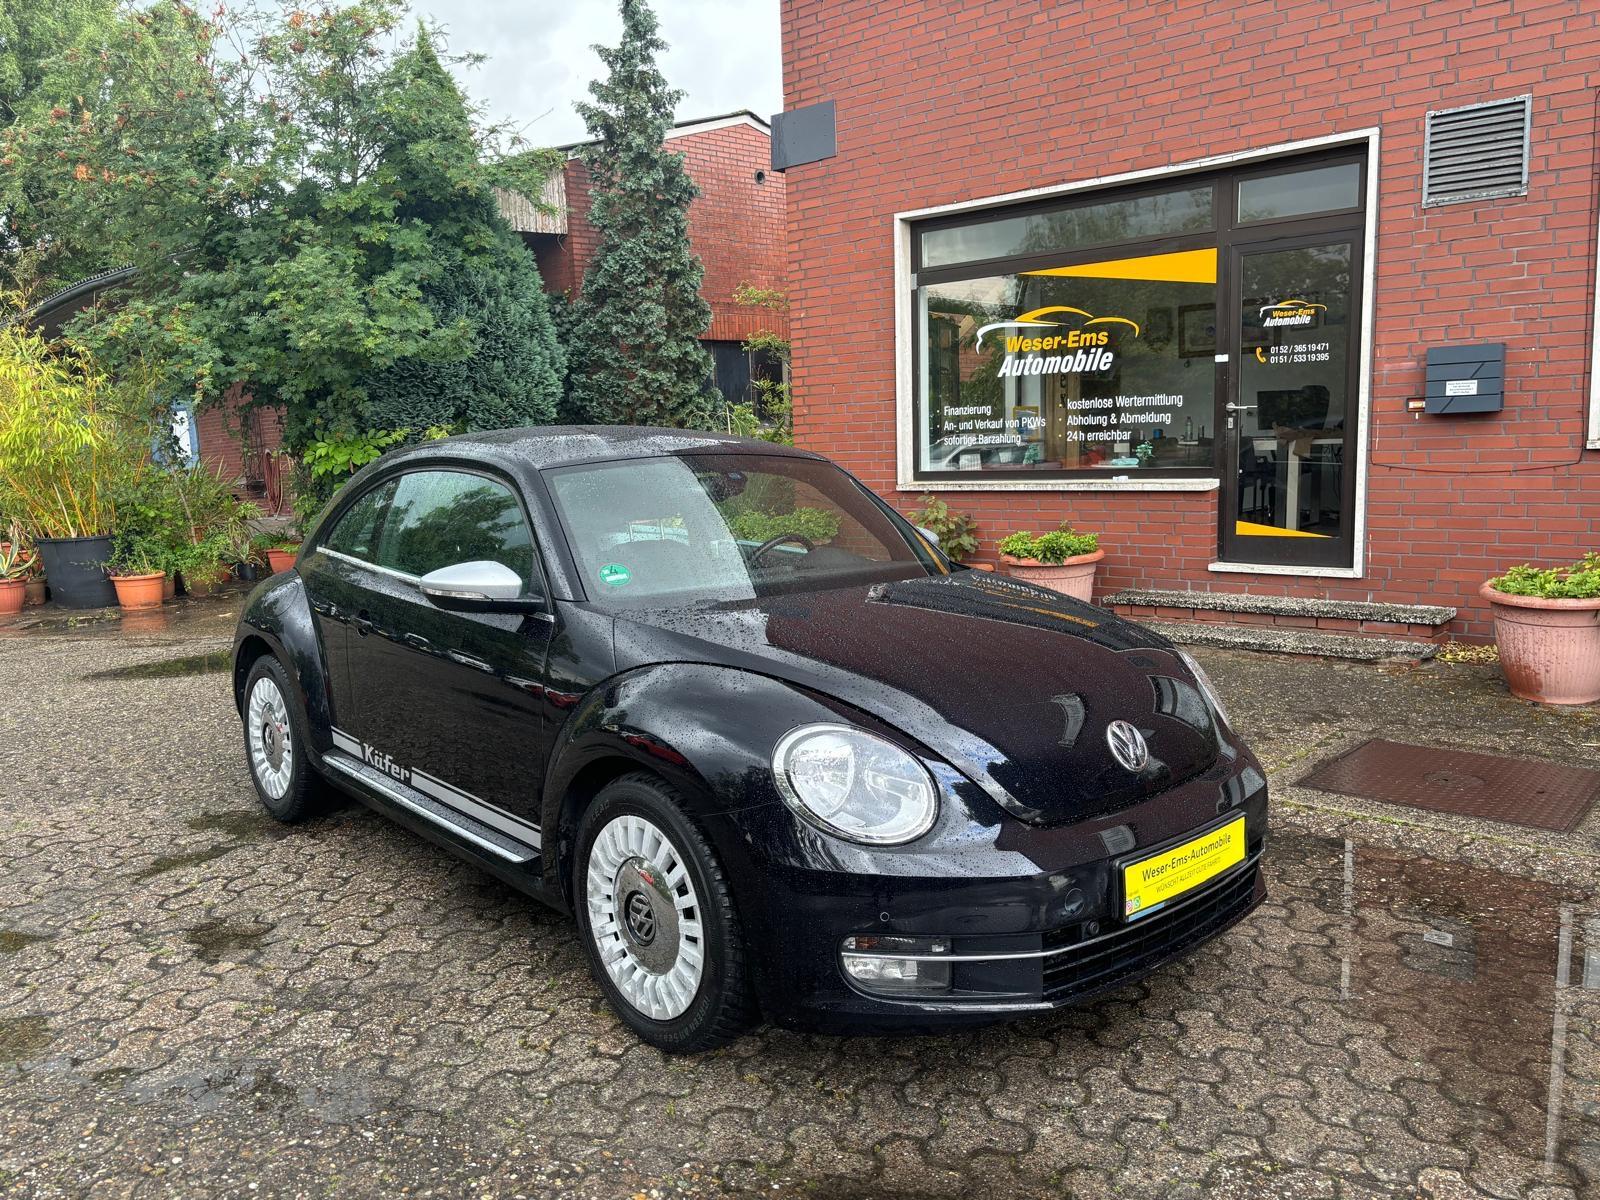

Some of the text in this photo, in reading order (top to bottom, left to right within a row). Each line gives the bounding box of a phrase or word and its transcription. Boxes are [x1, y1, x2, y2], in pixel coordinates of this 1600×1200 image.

[1272, 308, 1315, 317] Weser-Ems
[1263, 315, 1311, 327] Automobile
[1006, 330, 1109, 353] Weser-Ems
[997, 347, 1114, 378] Automobile
[1066, 393, 1183, 410] kostenlose Wertermittlung
[943, 405, 992, 416] Finanzierung
[943, 416, 1046, 431] An- und Verkauf von PKWs
[1066, 411, 1171, 426] Abholung & Abmeldung
[943, 433, 1021, 446] sofortige Barzahlung
[1087, 429, 1132, 441] erreichbar
[363, 742, 410, 780] Käfer
[1142, 833, 1231, 881] Weser-Ems-Automobile
